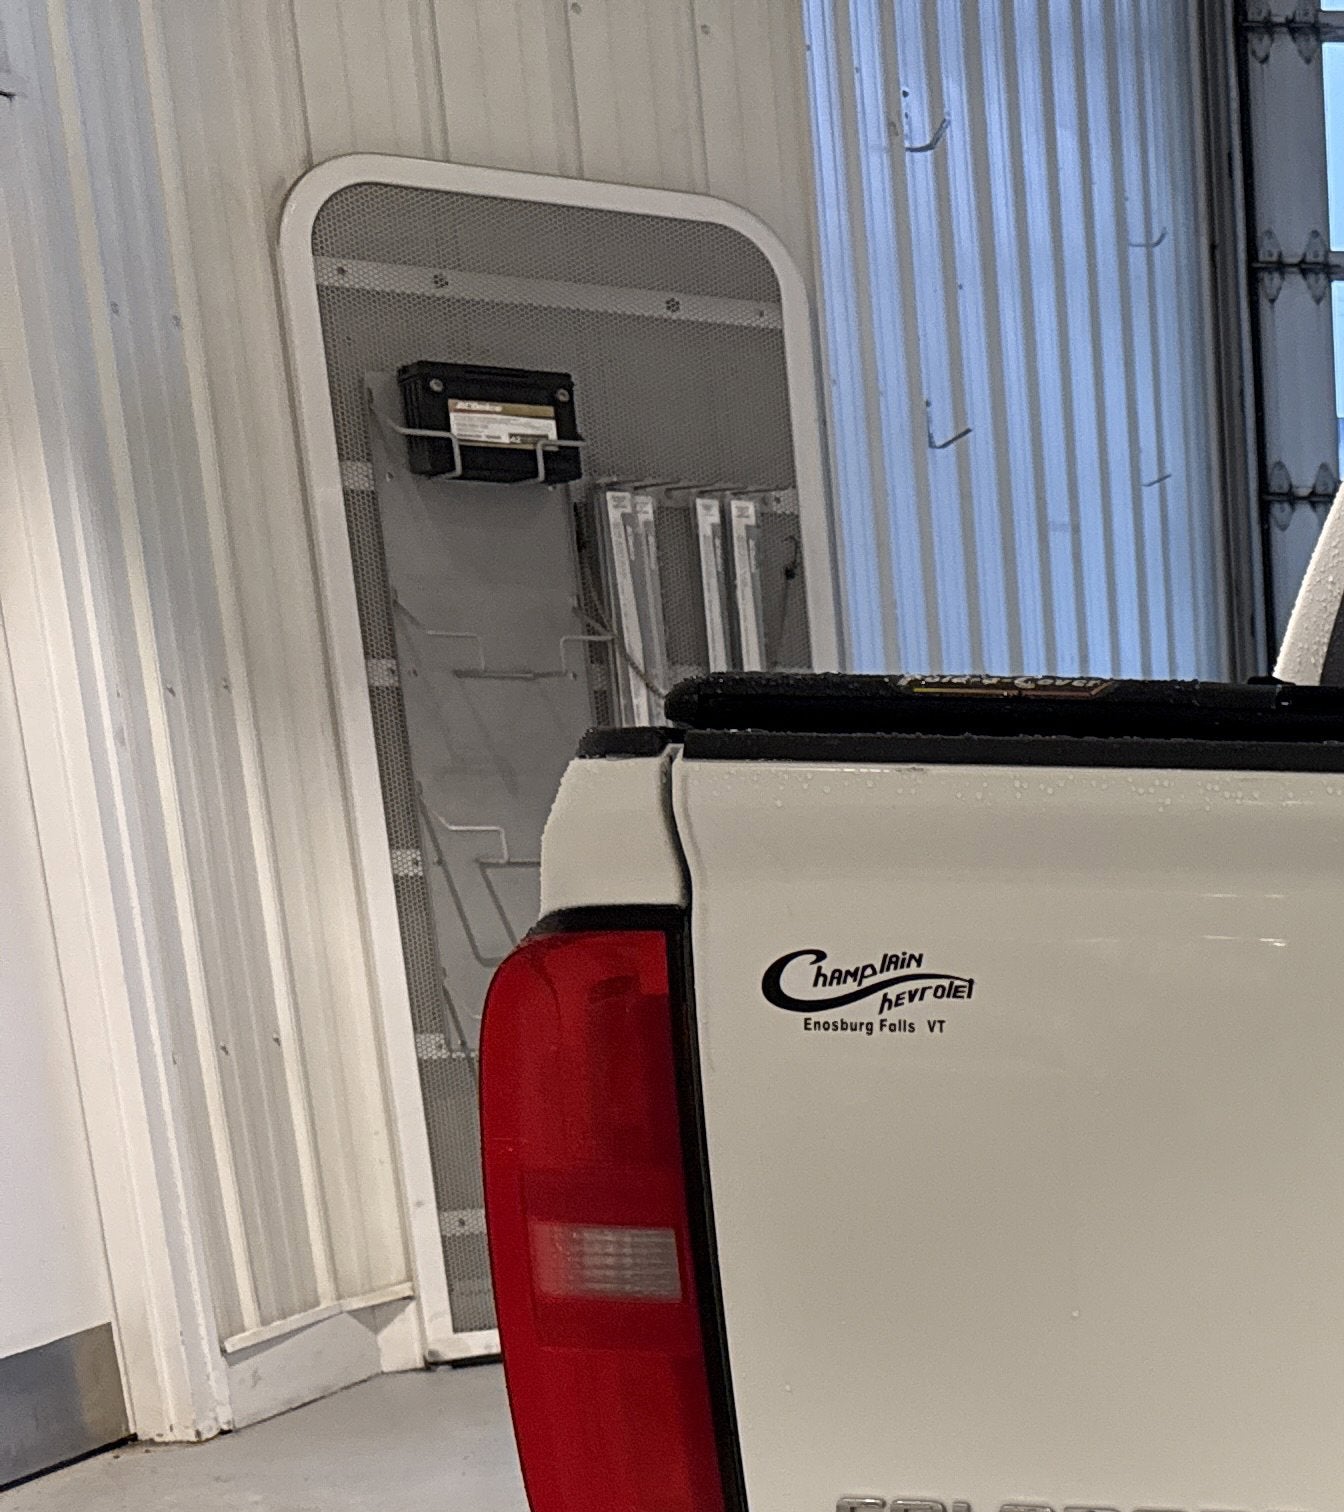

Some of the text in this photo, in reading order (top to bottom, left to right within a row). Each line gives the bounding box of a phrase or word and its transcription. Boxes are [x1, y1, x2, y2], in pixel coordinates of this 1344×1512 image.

[803, 1017, 947, 1036] Enosburg Falls VT
